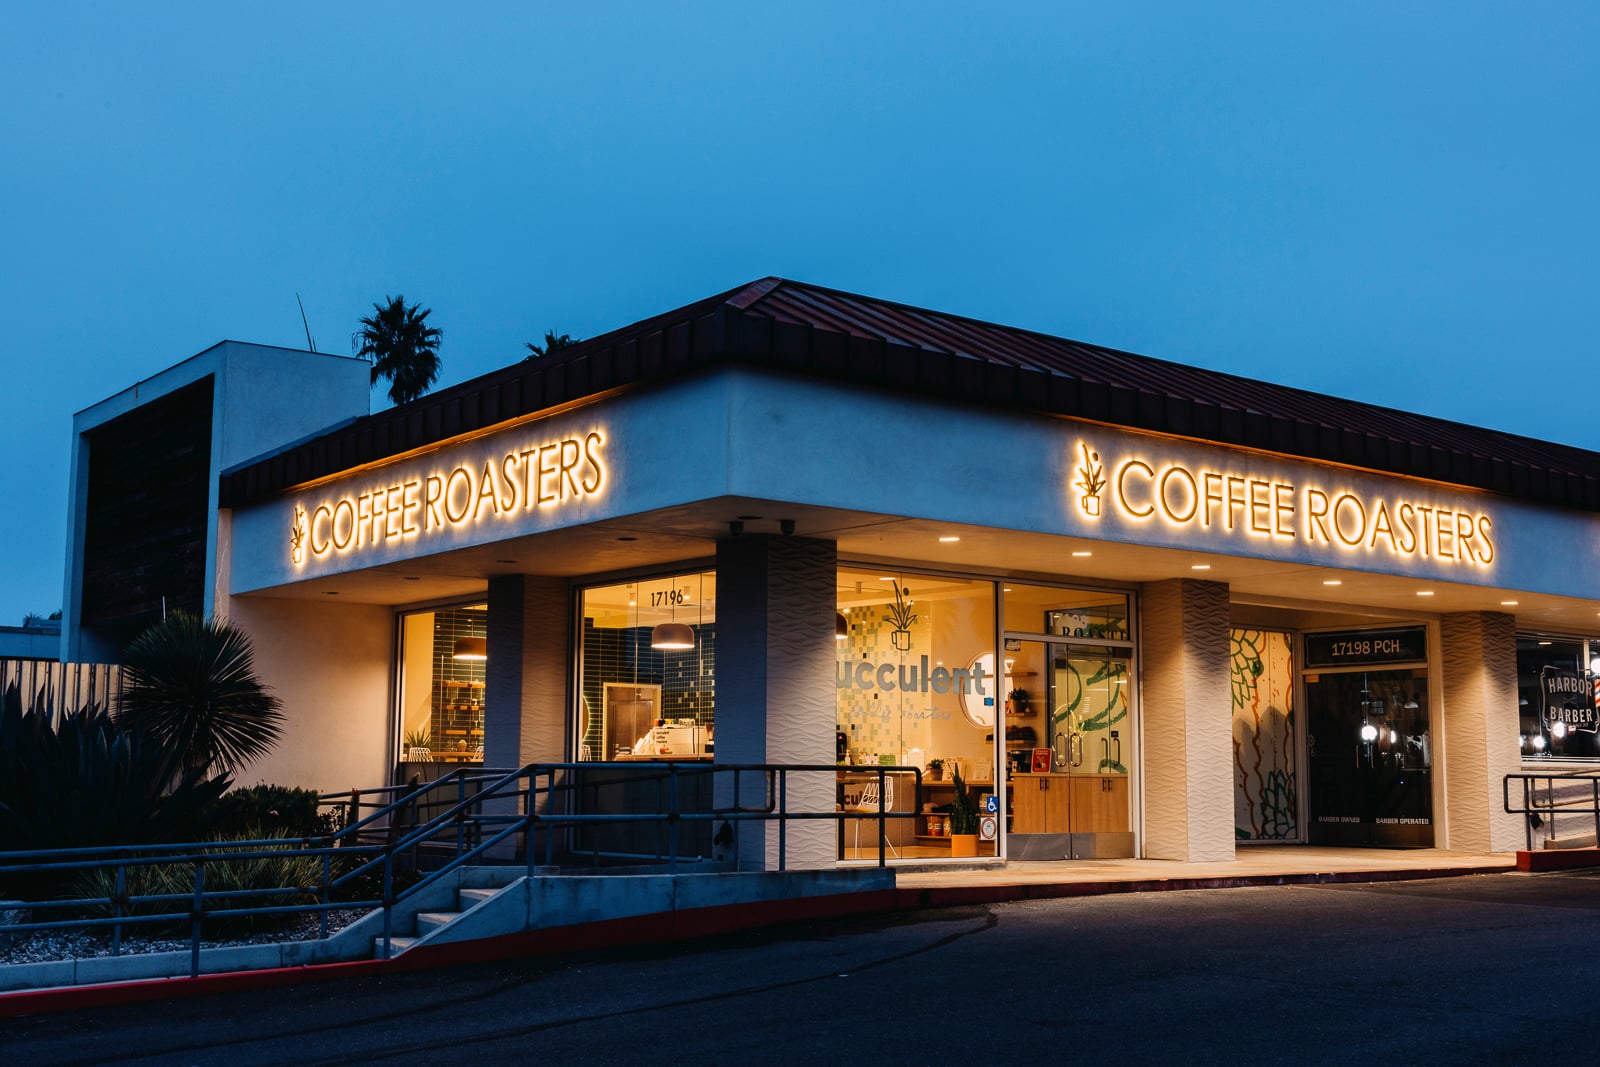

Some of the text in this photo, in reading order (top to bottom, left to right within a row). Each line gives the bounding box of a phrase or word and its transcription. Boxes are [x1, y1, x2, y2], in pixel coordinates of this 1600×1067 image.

[310, 432, 603, 555] COFFEE ROASTERS
[1117, 459, 1494, 564] COFFEE ROASTERS
[651, 589, 683, 607] 17196
[1331, 639, 1400, 656] 17198 PCH
[836, 654, 986, 696] ucculent
[1548, 676, 1593, 697] HARBOR
[1550, 705, 1593, 723] BARBER
